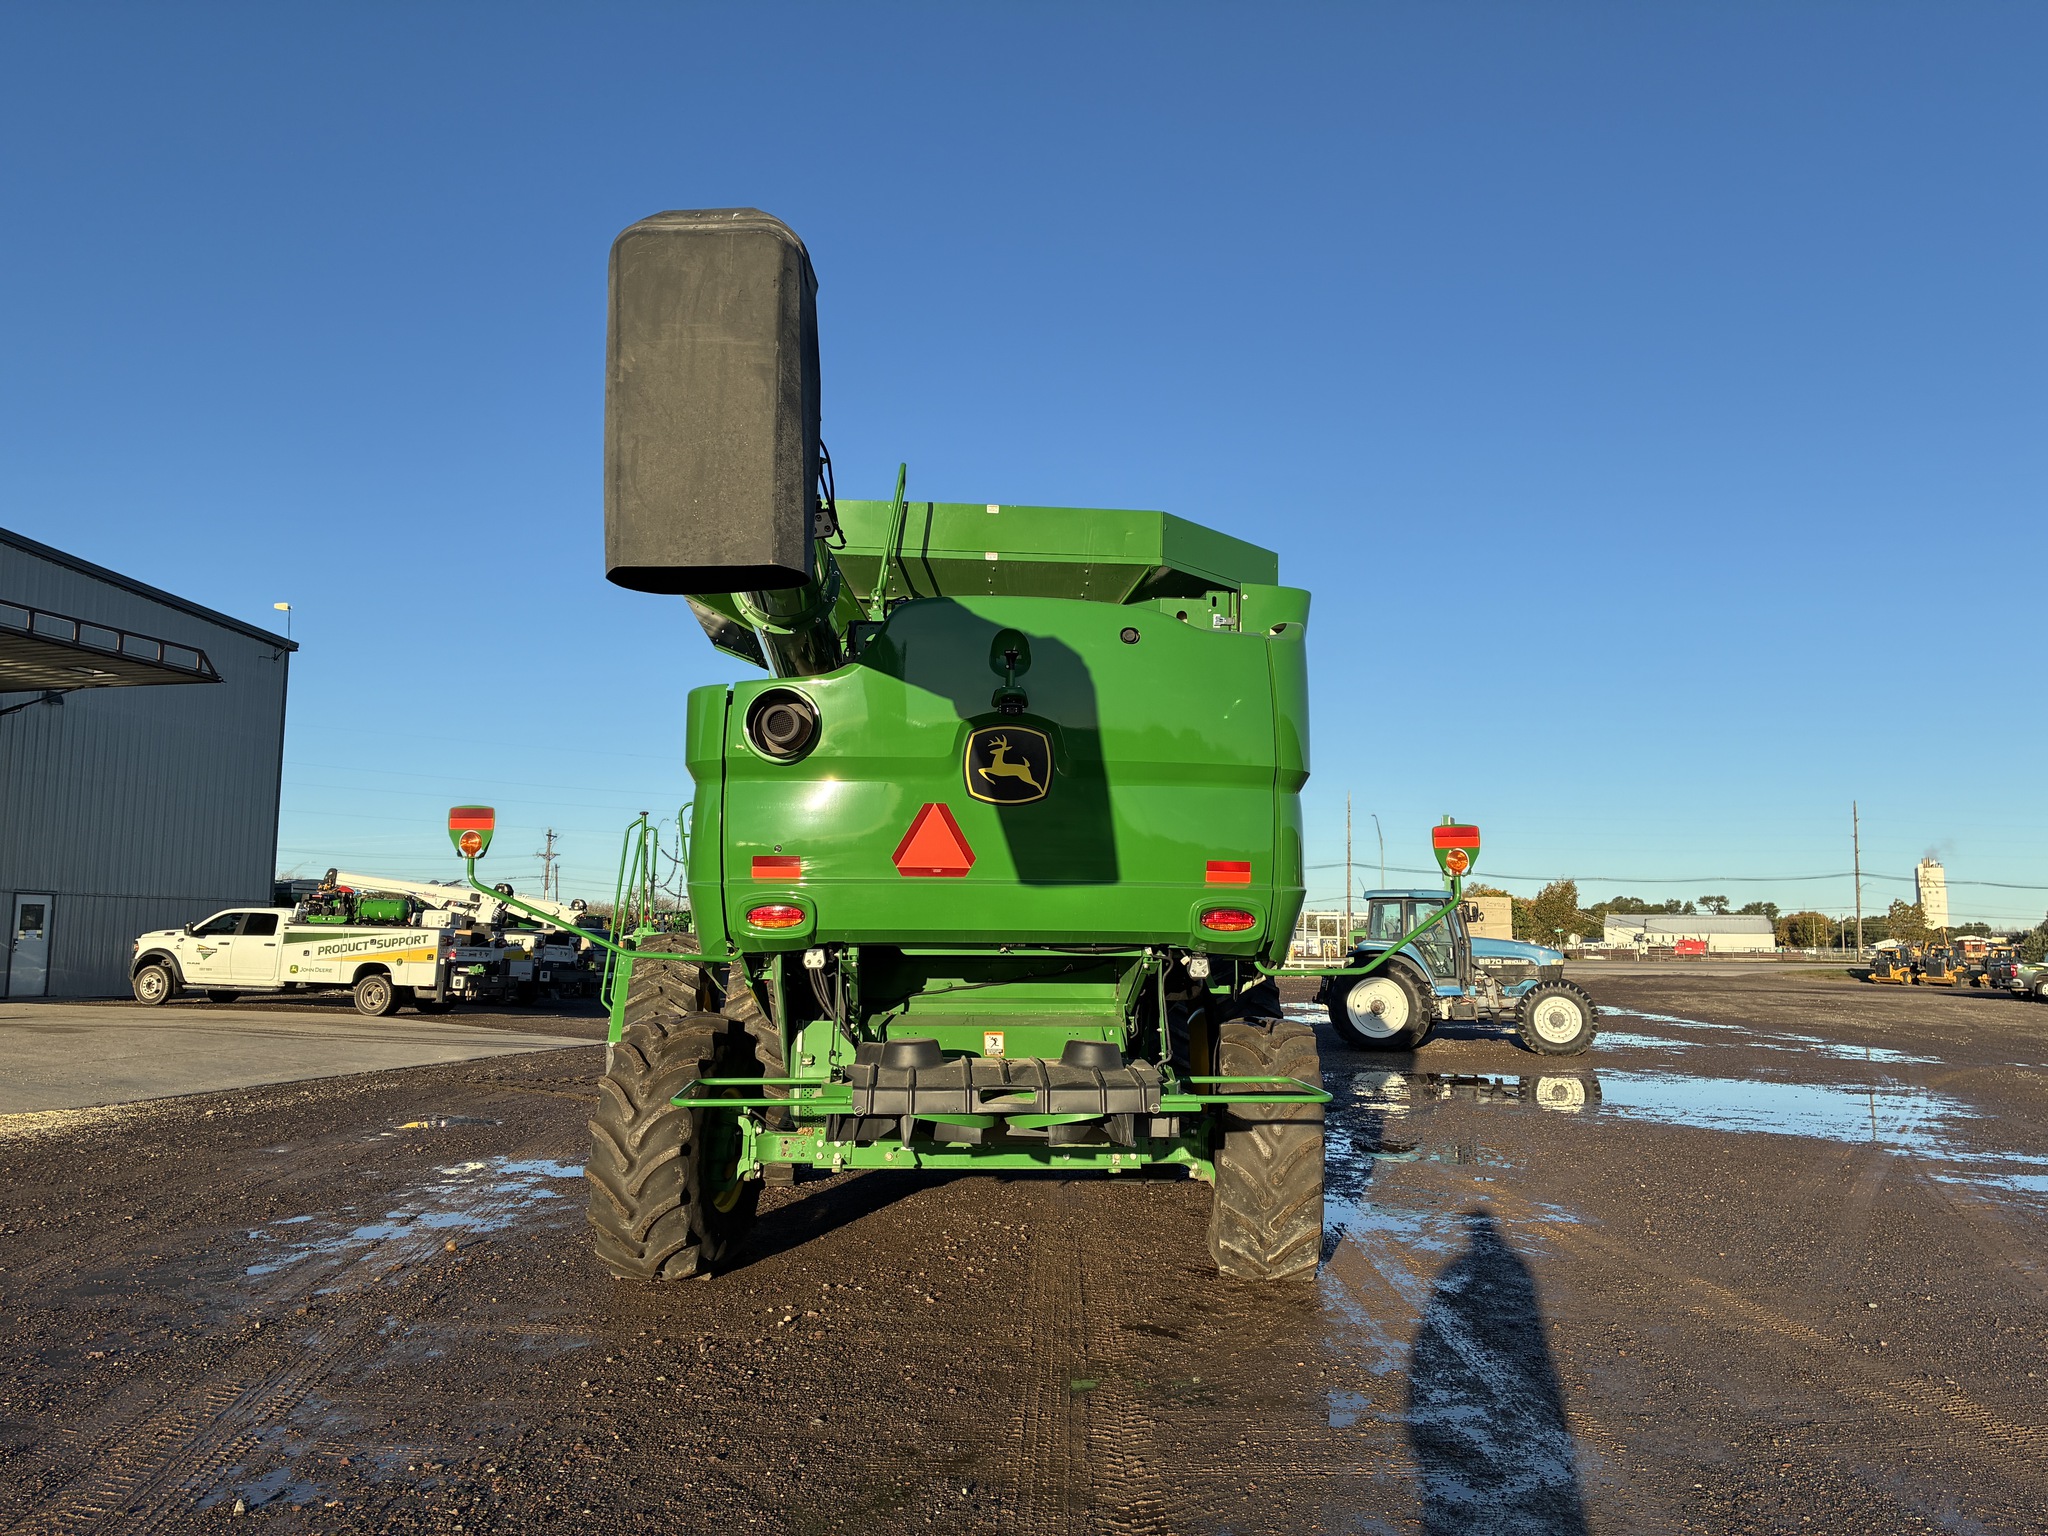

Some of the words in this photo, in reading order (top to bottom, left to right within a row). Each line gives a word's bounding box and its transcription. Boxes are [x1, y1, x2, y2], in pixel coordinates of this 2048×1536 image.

[317, 941, 370, 956] PRODUCT
[376, 934, 429, 949] SUPPORT
[315, 966, 333, 974] DEERE
